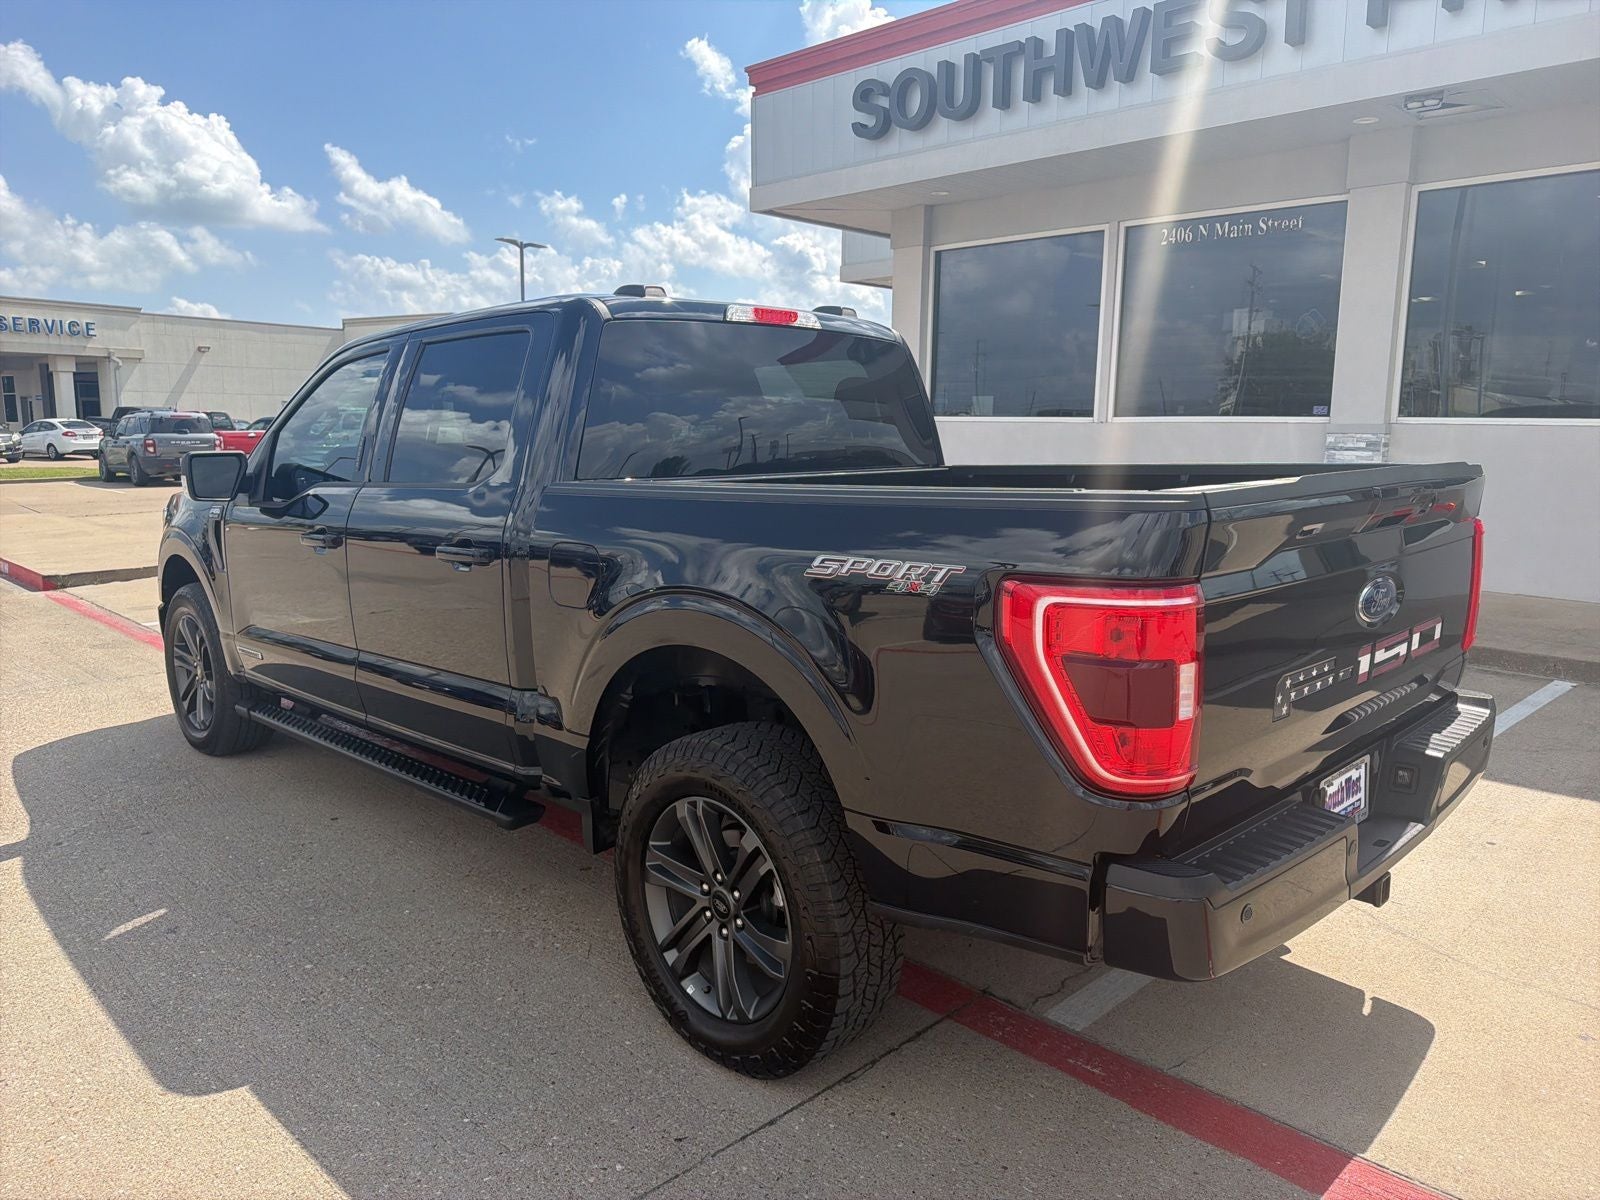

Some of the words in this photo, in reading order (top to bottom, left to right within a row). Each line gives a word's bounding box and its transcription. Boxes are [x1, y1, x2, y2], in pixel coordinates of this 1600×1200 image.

[1160, 225, 1193, 246] 2406
[1197, 223, 1209, 241] N
[1213, 219, 1252, 240] Main
[1257, 215, 1304, 235] Street
[0, 313, 97, 338] SERVICE
[803, 555, 967, 584] SPORT
